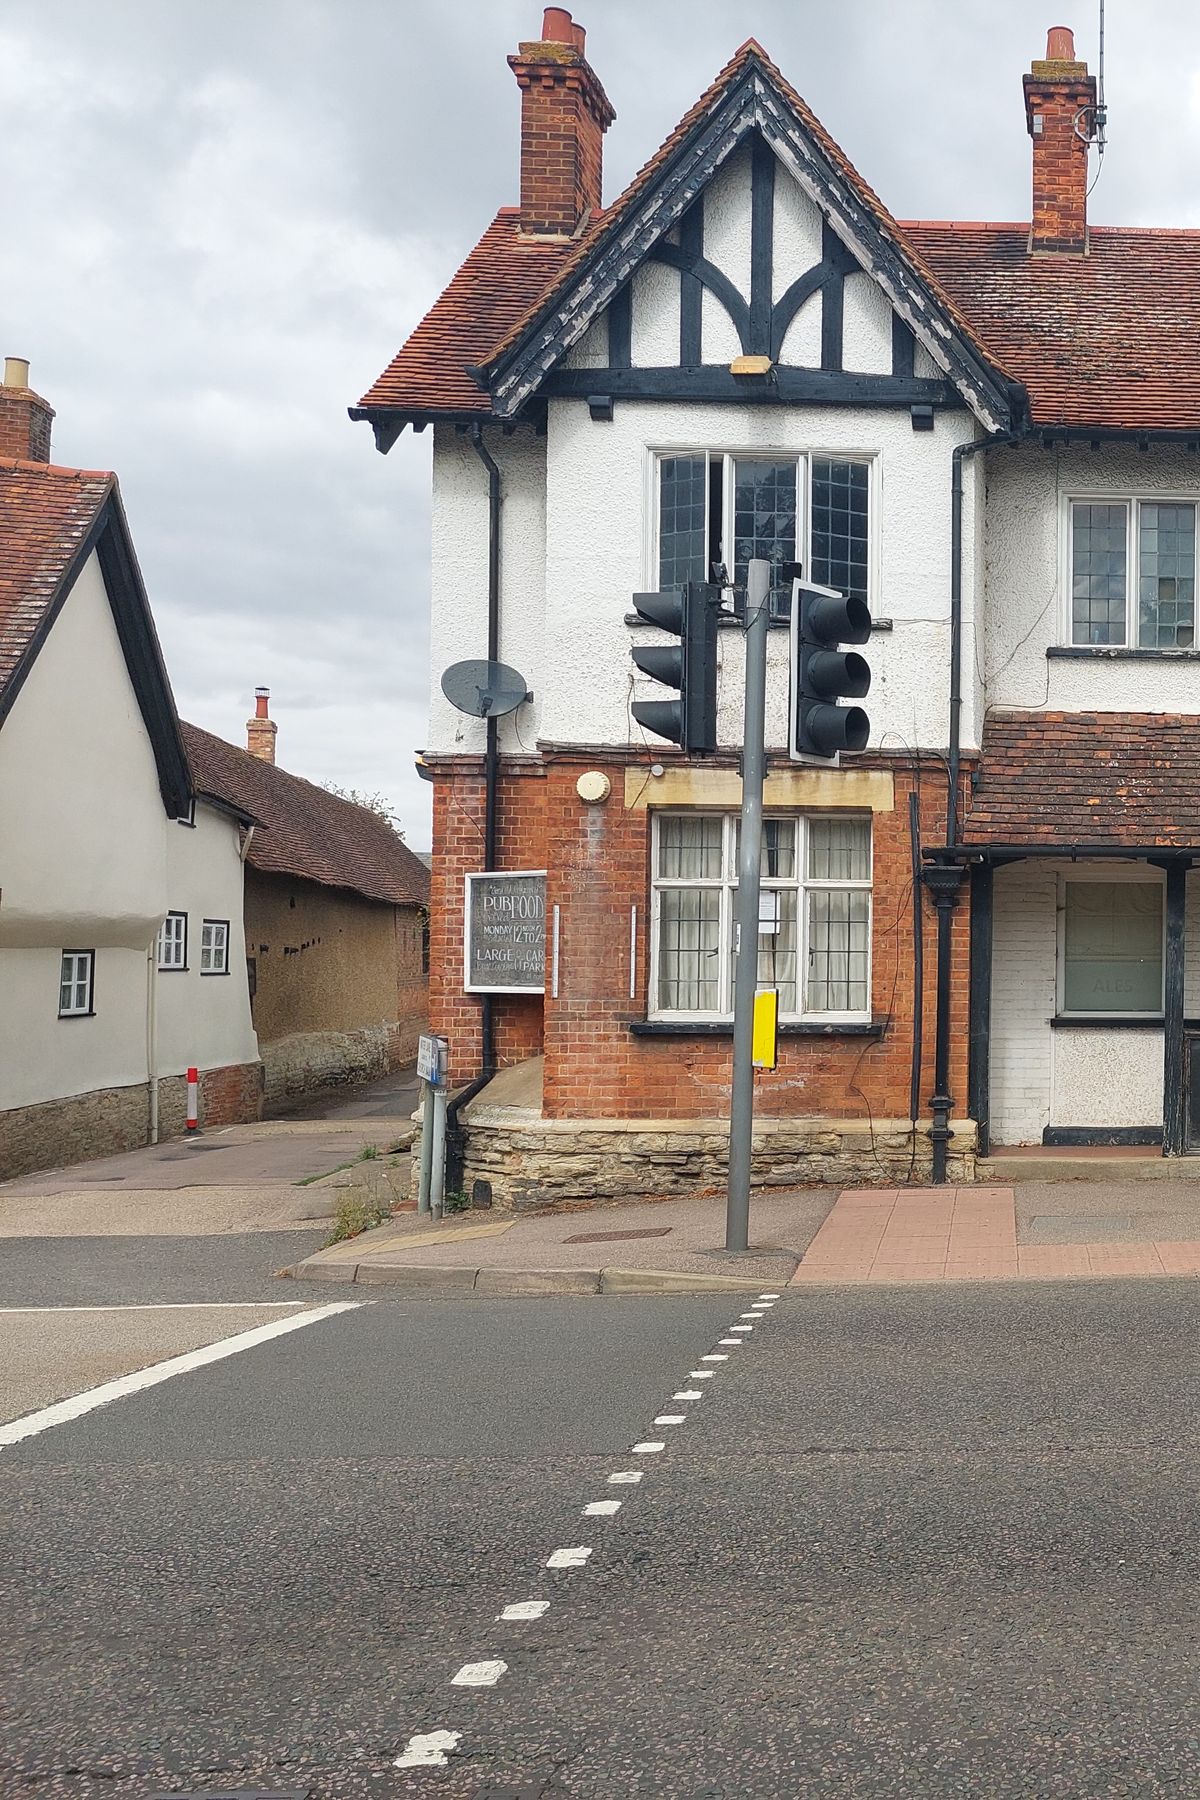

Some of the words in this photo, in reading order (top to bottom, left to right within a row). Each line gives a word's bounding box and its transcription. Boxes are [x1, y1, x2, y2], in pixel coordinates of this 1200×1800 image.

[483, 896, 511, 911] PUB
[511, 895, 544, 919] FOOD
[483, 925, 513, 935] MONDAY
[513, 925, 523, 943] 12
[477, 949, 515, 961] LARGE
[526, 949, 545, 962] CAR
